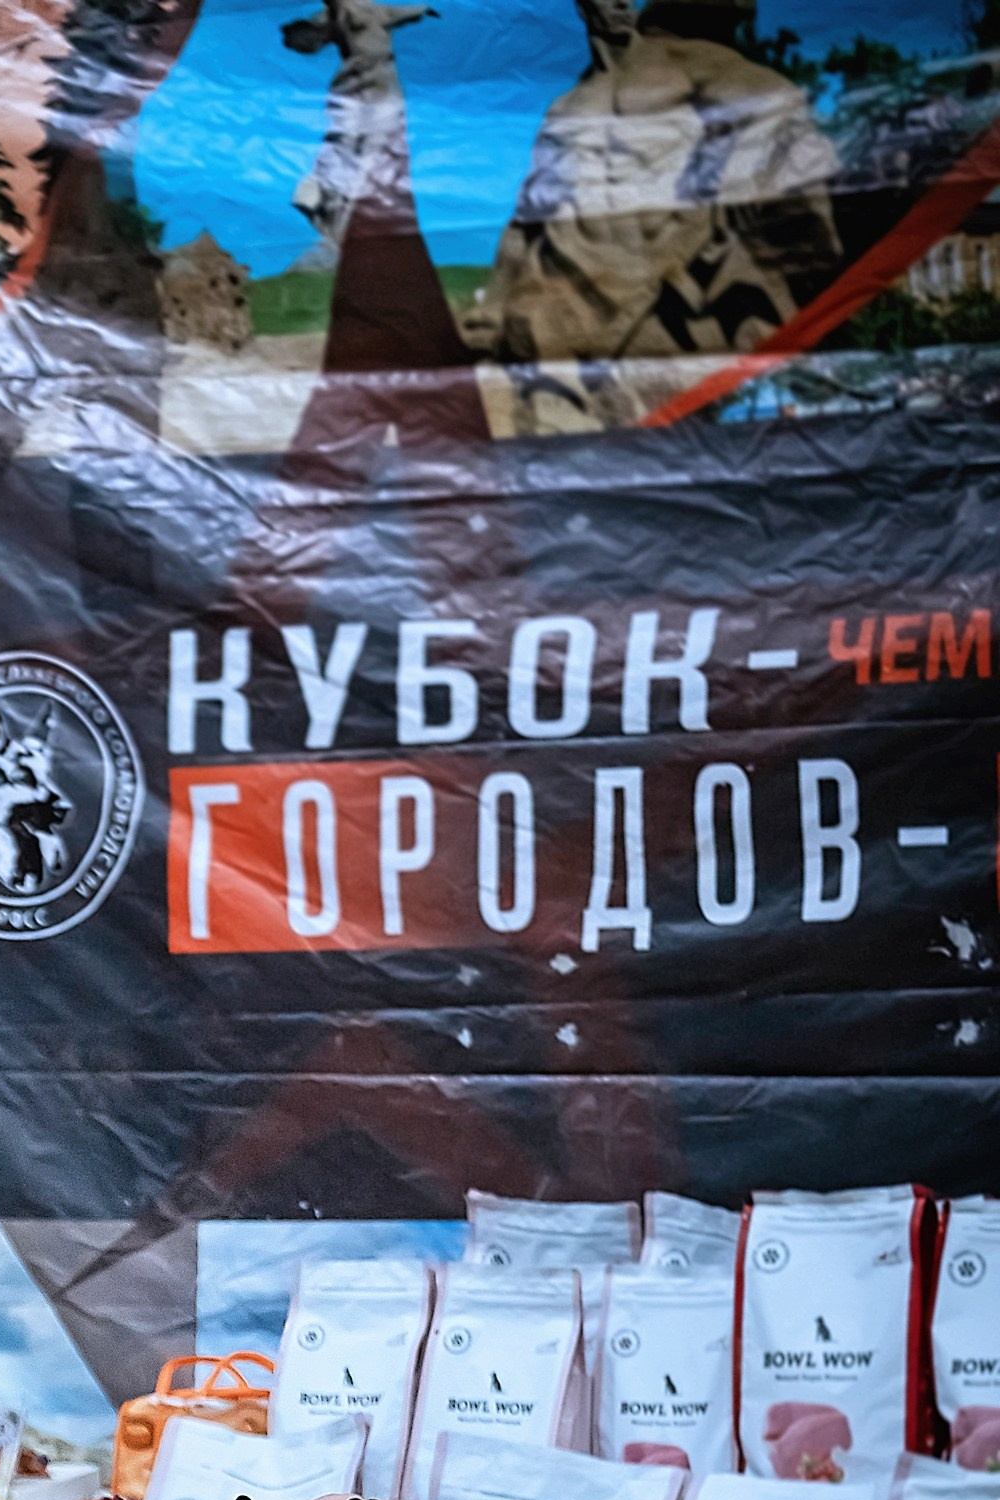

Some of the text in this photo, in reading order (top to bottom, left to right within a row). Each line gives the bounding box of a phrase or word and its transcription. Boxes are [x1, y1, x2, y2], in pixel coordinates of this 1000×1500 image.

[828, 608, 992, 686] ЧЕМ
[763, 1352, 873, 1368] BOWL WOW
[951, 1358, 1000, 1375] BOW
[300, 1392, 382, 1406] BOWL WOW
[448, 1399, 534, 1415] BOWL WOW
[621, 1402, 708, 1416] BOWL WOW
